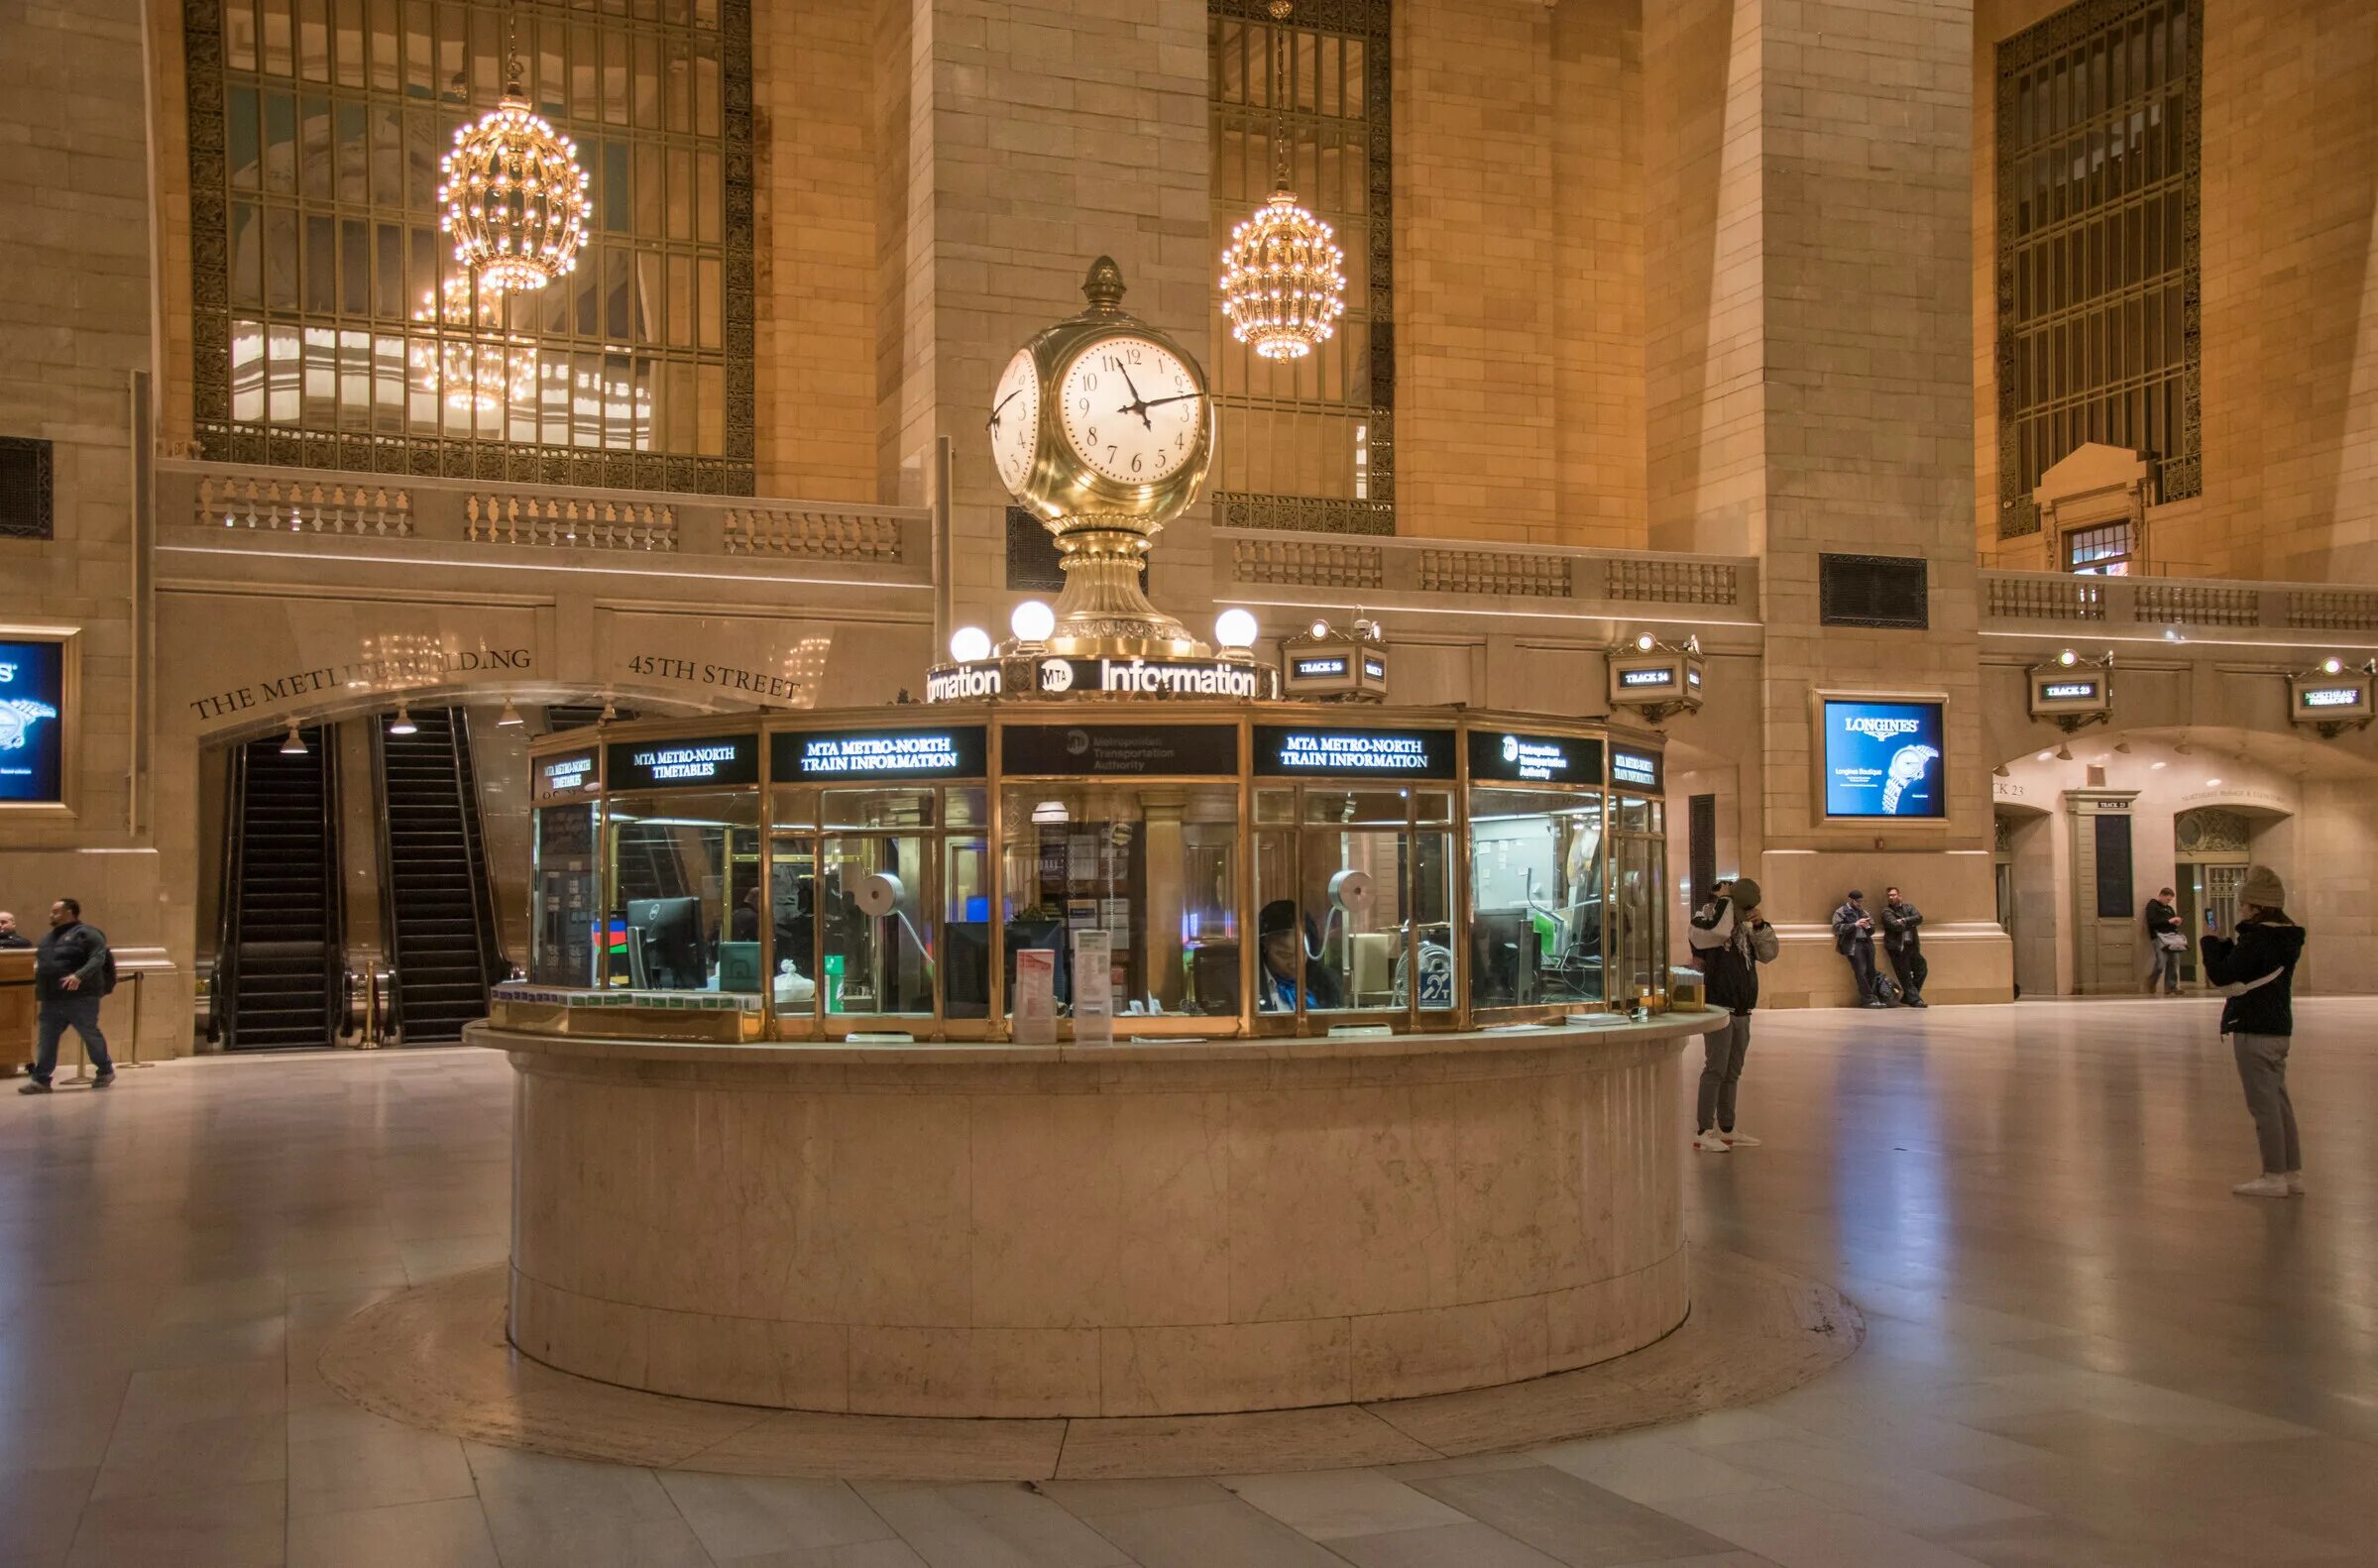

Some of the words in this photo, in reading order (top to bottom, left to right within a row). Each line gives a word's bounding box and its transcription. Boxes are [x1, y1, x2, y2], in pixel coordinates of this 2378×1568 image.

[1102, 355, 1115, 372] 11
[1126, 349, 1142, 365] 12
[1158, 357, 1164, 374] 1
[1082, 373, 1097, 392] 10
[1175, 376, 1184, 393] 2
[1079, 397, 1089, 419] 9
[1180, 403, 1189, 423] 3
[1086, 426, 1097, 446] 8
[1175, 431, 1185, 450] 4
[1107, 445, 1117, 464] 7
[1131, 453, 1142, 473] 6
[1155, 449, 1167, 468] 5
[1301, 663, 1330, 673] TRACK
[628, 654, 696, 682] 45TH
[703, 663, 801, 700] STREET
[927, 666, 1002, 704] ormation
[1101, 658, 1256, 698] Information
[1626, 674, 1656, 684] TRACK
[2047, 686, 2079, 697] TRACK
[2305, 689, 2358, 700] NORTHEAST
[190, 688, 256, 721] THE
[1845, 718, 1918, 733] LONGINES
[807, 742, 840, 756] MTA
[842, 736, 952, 755] METRO-NORTH
[1288, 736, 1318, 751] MTA
[1320, 737, 1422, 753] METRO-NORTH
[634, 750, 656, 766] MTA
[657, 746, 736, 764] METRO-NORTH
[801, 757, 849, 771] TRAIN
[850, 752, 958, 770] INFORMATION
[1094, 747, 1175, 760] Transportation
[1281, 751, 1327, 766] TRAIN
[1329, 752, 1428, 768] INFORMATION
[653, 762, 715, 779] TIMETABLES
[1093, 760, 1146, 772] Authority
[1835, 767, 1859, 776] Longines
[1860, 767, 1882, 776] Boutique
[2011, 784, 2024, 797] 23
